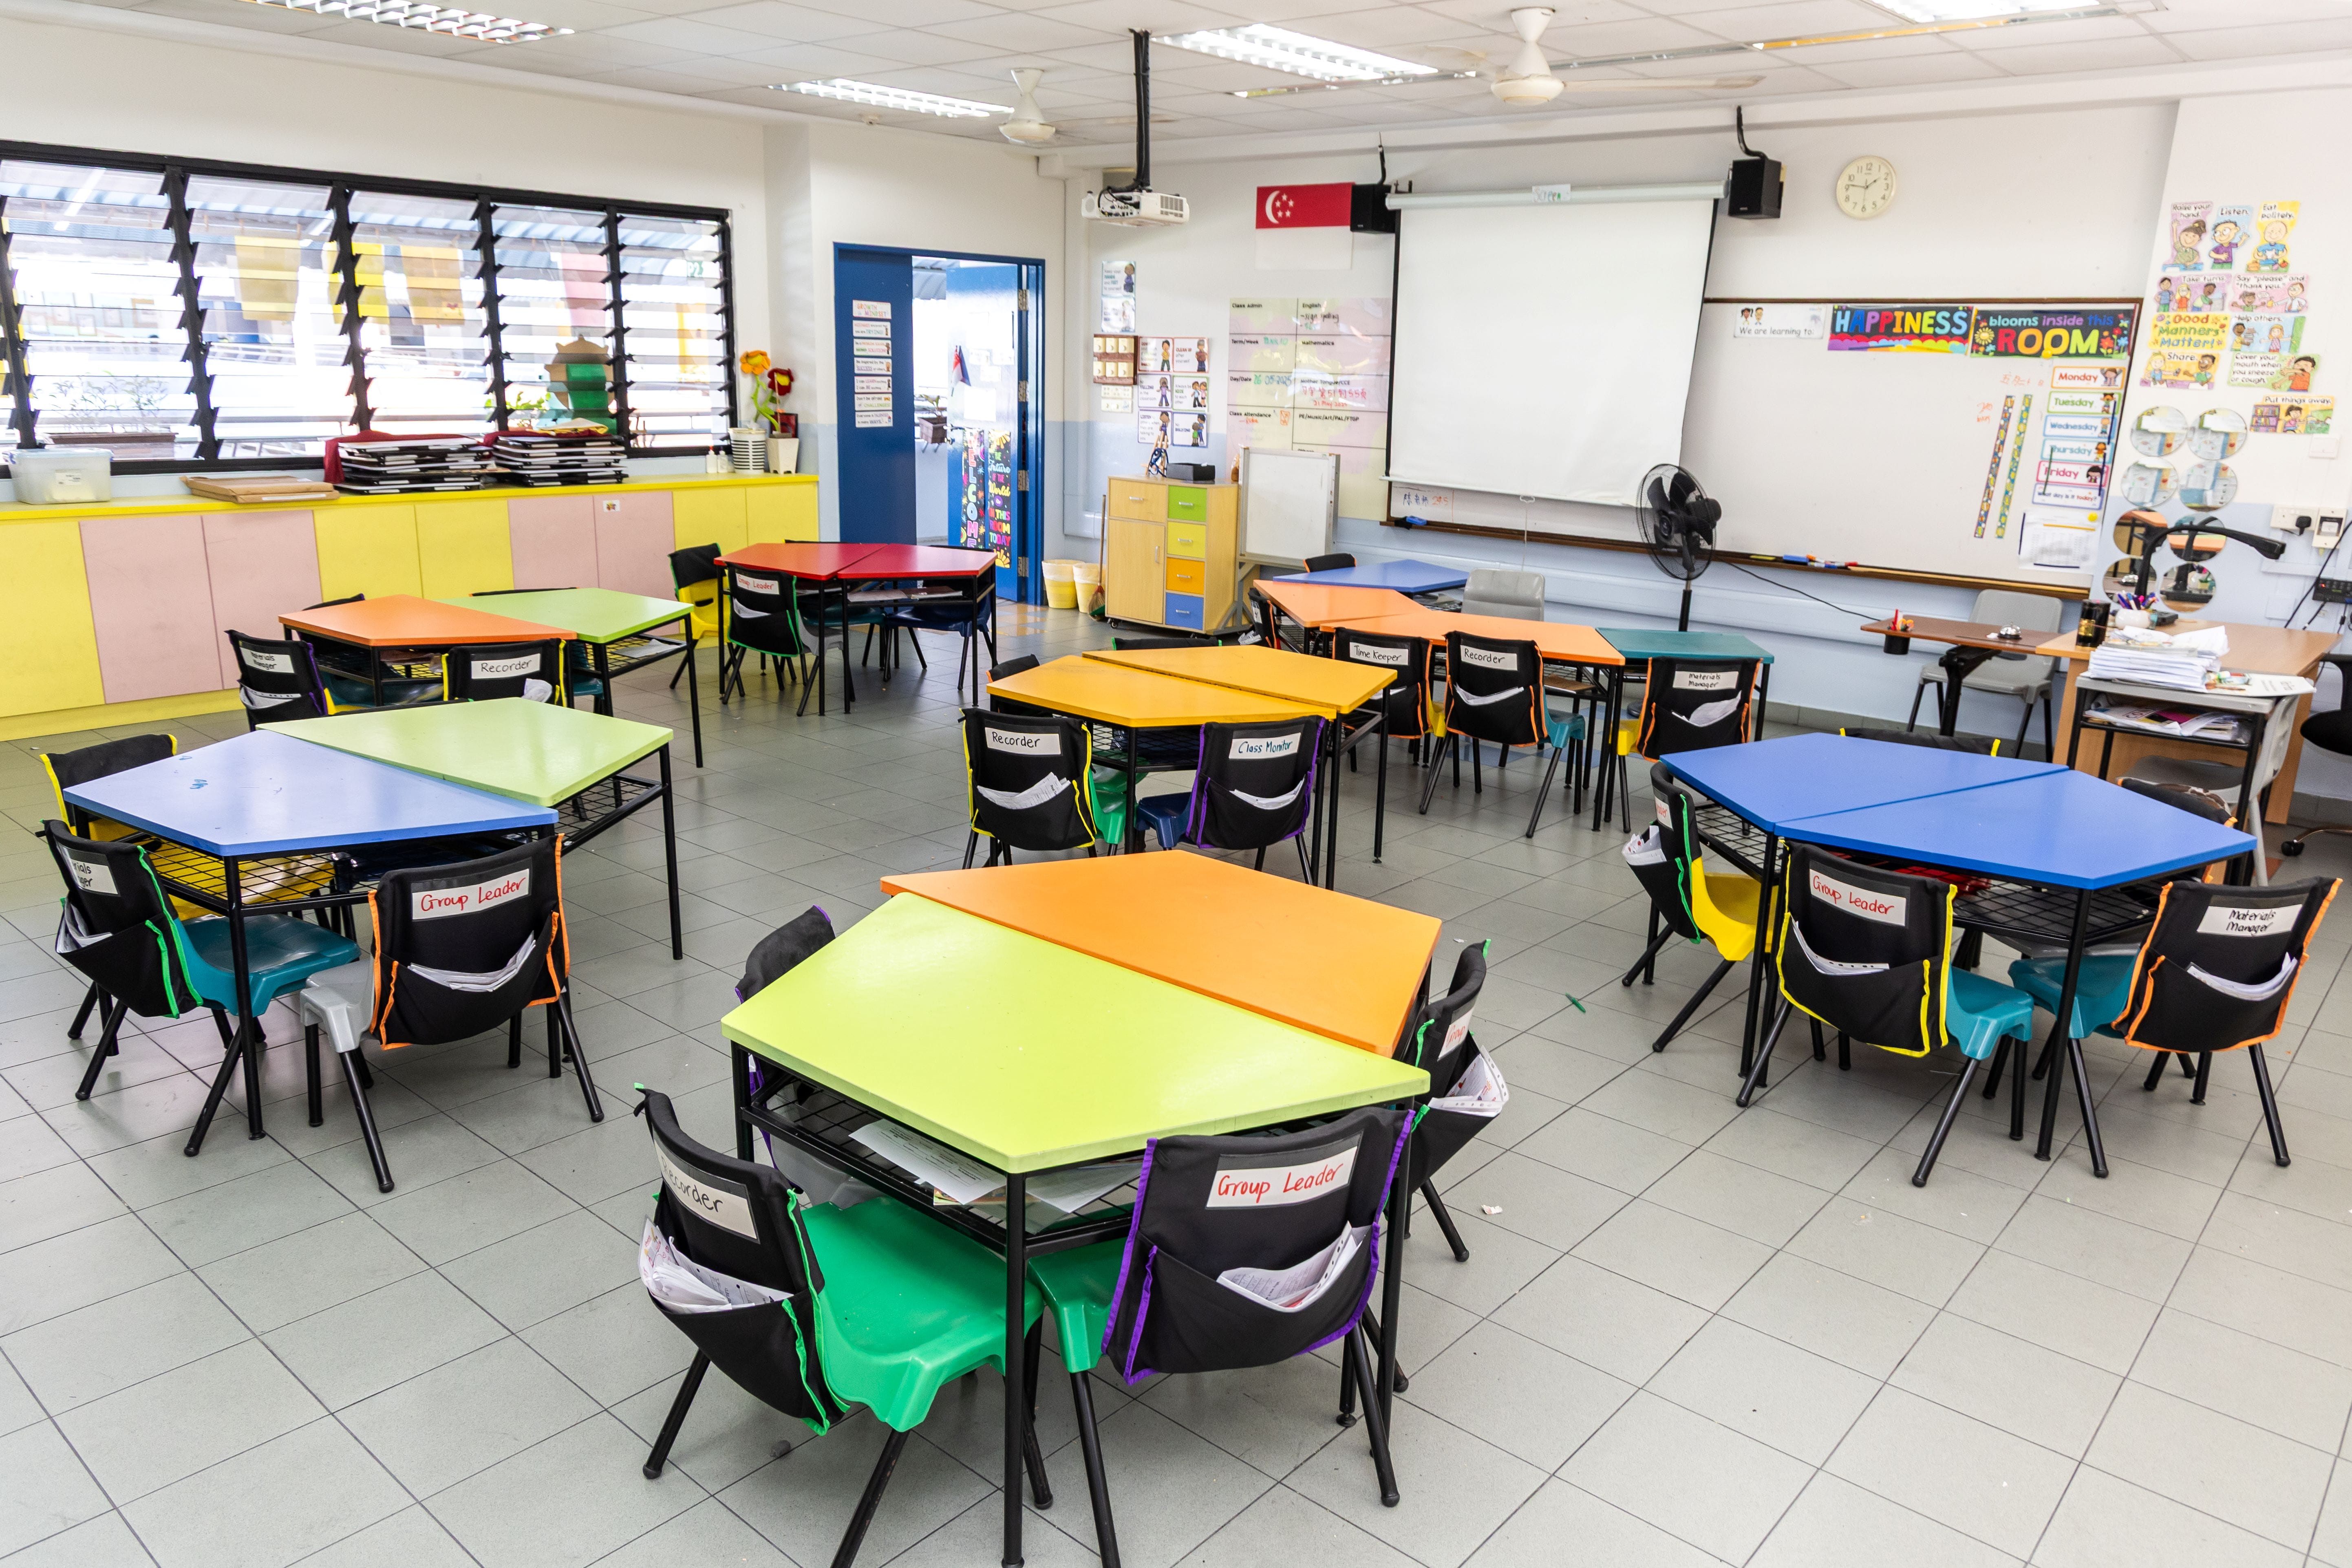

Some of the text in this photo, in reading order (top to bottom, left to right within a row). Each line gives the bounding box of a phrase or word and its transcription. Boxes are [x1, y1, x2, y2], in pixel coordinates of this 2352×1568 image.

[1835, 310, 1967, 335] HAPPINESS
[1989, 314, 2114, 326] blooms inside this
[2173, 315, 2209, 323] Good
[1739, 326, 1752, 335] We
[1770, 327, 1800, 337] learning
[2158, 326, 2219, 336] Manners
[1997, 328, 2099, 355] ROOM
[2160, 337, 2215, 347] Matter!
[2167, 352, 2198, 360] Share.
[2059, 373, 2098, 383] Monday
[2054, 397, 2094, 408] Tuesday
[2050, 422, 2098, 431] Wednesday
[989, 460, 1011, 474] Future
[988, 482, 1011, 496] World
[989, 508, 1010, 521] IN THIS
[989, 519, 1011, 534] ROOM
[989, 532, 1011, 546] TODAY
[738, 575, 774, 590] Group Leader
[1354, 645, 1402, 663] Time Keeper
[1464, 648, 1505, 664] Recorder
[253, 659, 277, 670] Manager
[481, 659, 532, 672] Recorder
[1688, 680, 1719, 690] Manager
[992, 731, 1040, 748] Recorder
[1238, 739, 1293, 754] Class Monitor
[421, 877, 526, 911] Group Leader
[1813, 875, 1894, 914] Group Leader
[2228, 909, 2276, 921] Materials
[2226, 921, 2274, 937] Manager
[661, 1155, 723, 1213] Recorder
[1217, 1163, 1343, 1204] Group Leader
